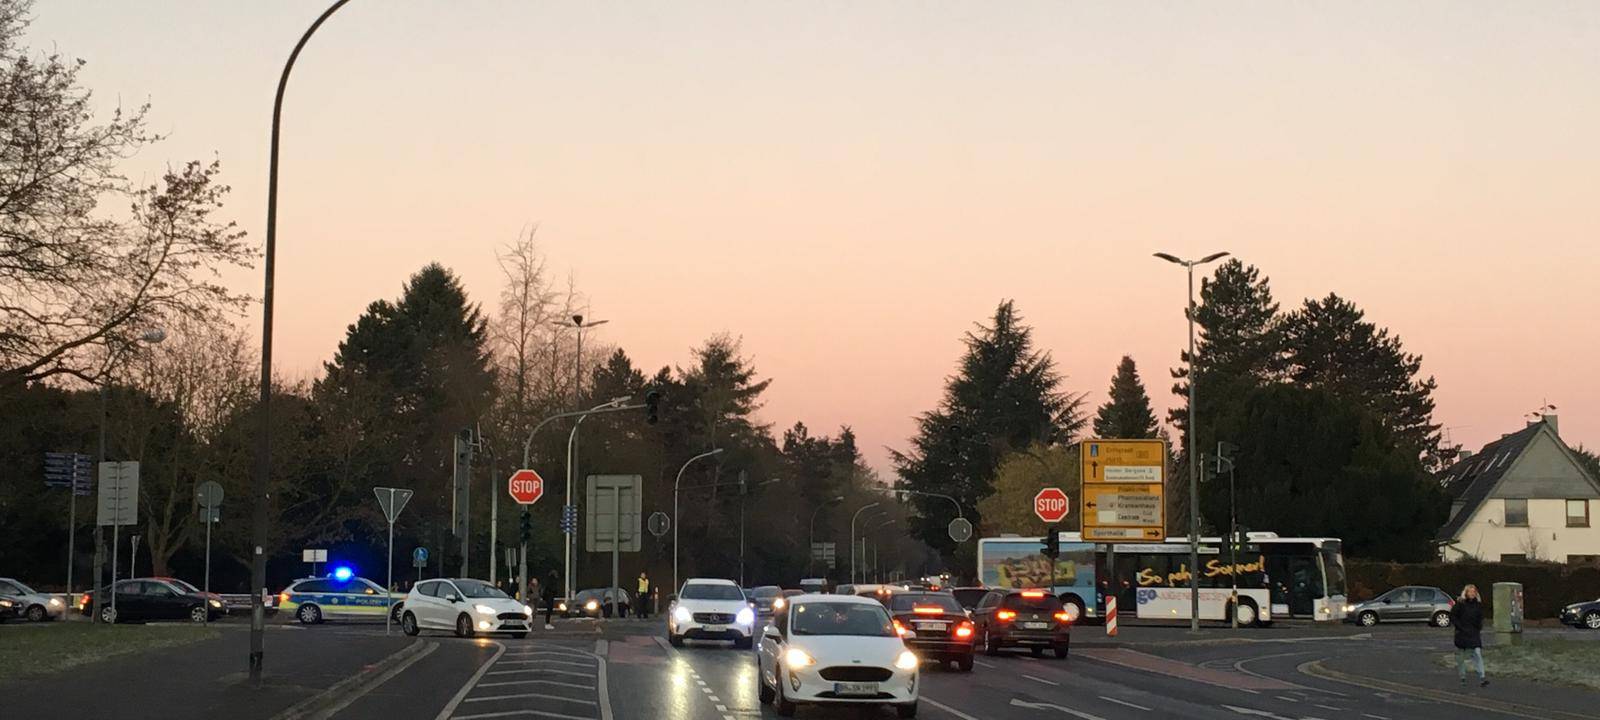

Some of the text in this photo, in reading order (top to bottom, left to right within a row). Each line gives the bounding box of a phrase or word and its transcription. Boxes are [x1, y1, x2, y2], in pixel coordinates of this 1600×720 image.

[512, 480, 540, 493] STOP
[1038, 498, 1065, 511] STOP
[1138, 567, 1163, 586] So
[1137, 589, 1156, 604] go
